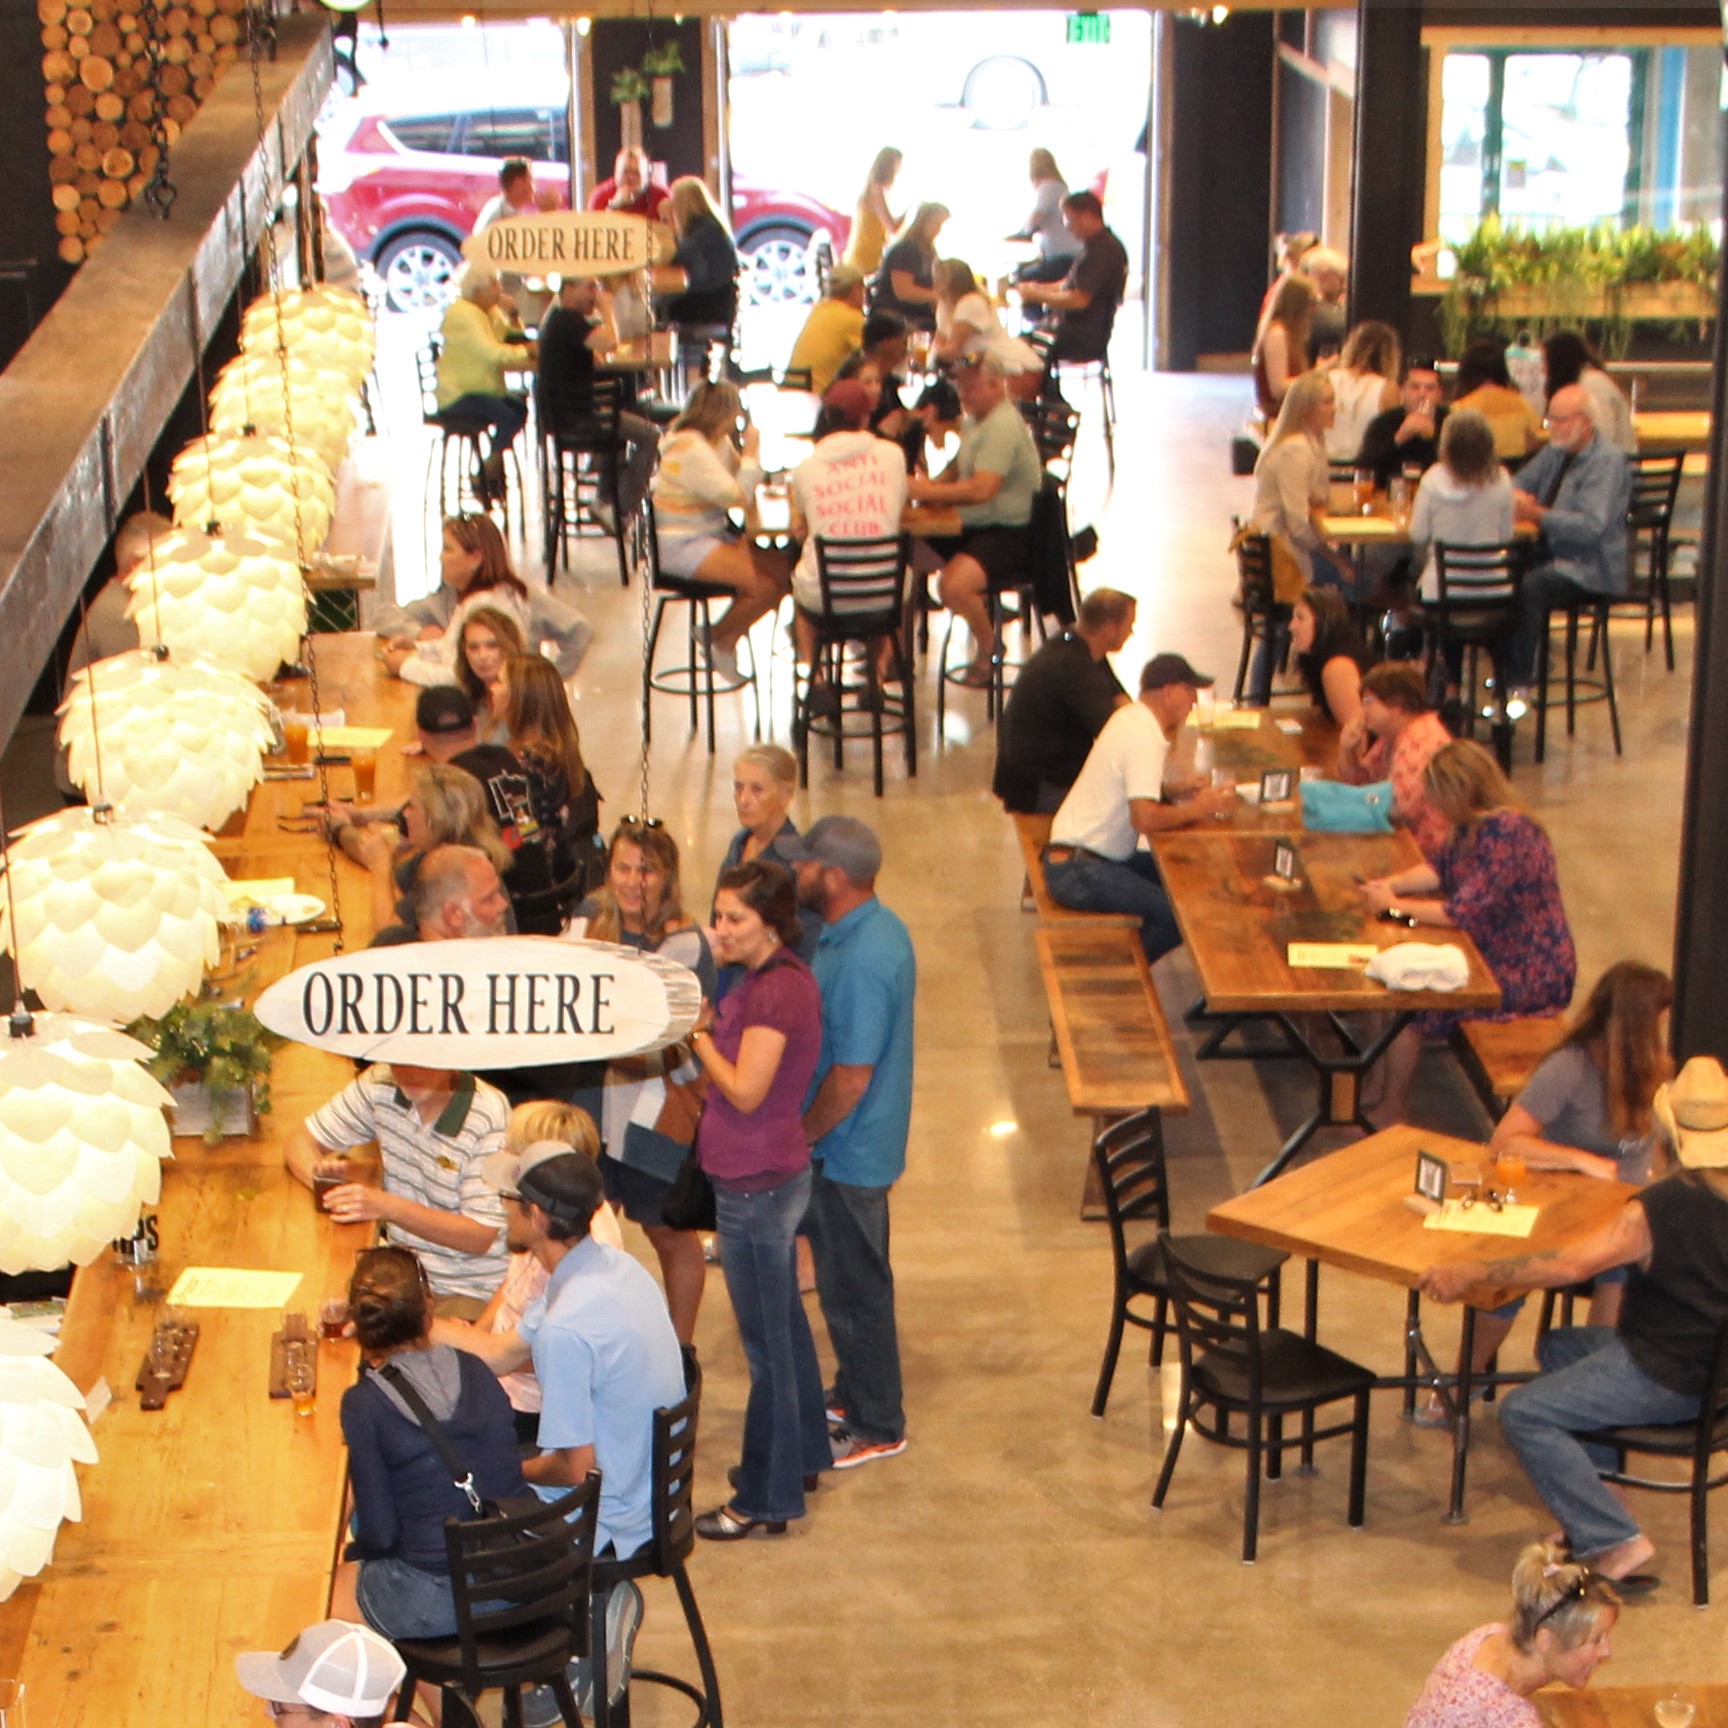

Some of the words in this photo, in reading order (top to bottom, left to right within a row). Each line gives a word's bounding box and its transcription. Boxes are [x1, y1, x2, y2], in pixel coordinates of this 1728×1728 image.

[487, 226, 566, 261] ORDER
[573, 226, 635, 261] HERE
[814, 471, 886, 497] SOCIAL
[815, 494, 888, 517] SOCIAL
[829, 520, 882, 538] CLUB
[302, 970, 471, 1037] ORDER
[485, 972, 617, 1036] HERE
